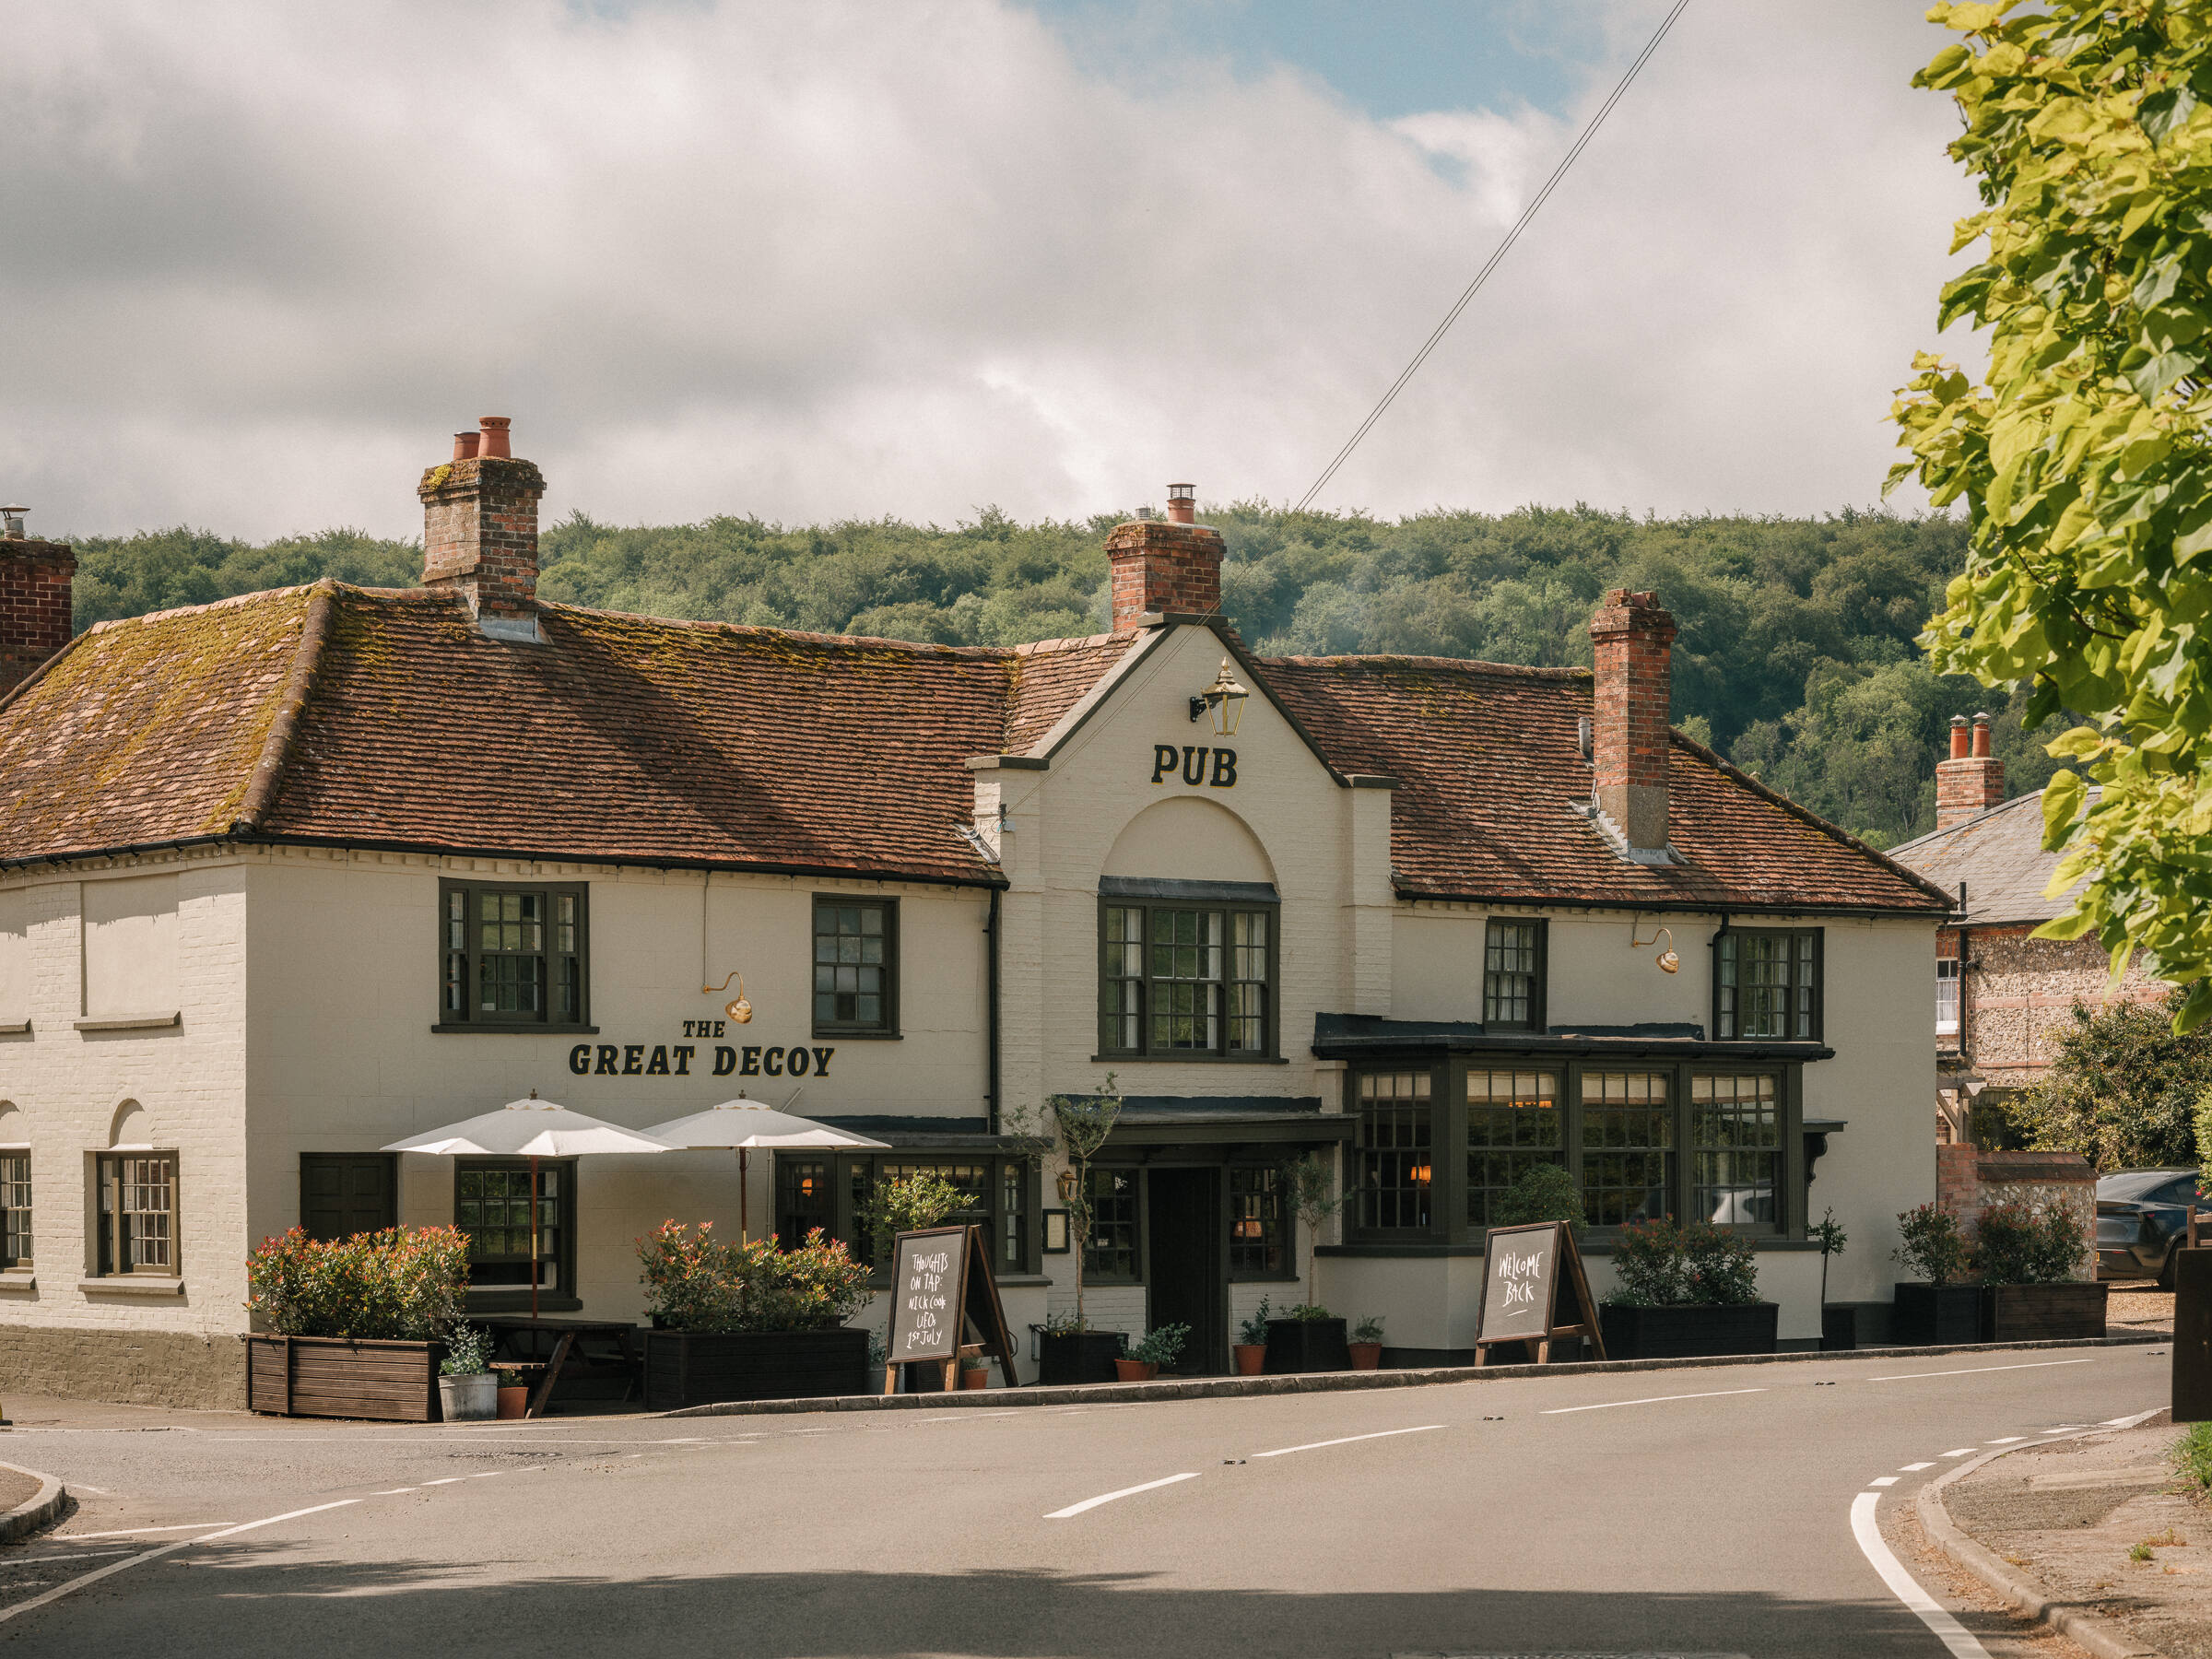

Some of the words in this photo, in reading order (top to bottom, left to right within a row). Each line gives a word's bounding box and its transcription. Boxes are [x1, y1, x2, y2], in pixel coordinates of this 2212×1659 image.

[1150, 744, 1238, 789] PUB
[682, 1020, 726, 1038] THE
[569, 1044, 695, 1076] GREAT
[712, 1046, 835, 1077] DECOY
[912, 1253, 948, 1273] THOUGHTS
[1499, 1251, 1544, 1280] WELCOME
[910, 1277, 921, 1290] ON
[924, 1272, 943, 1292] TAP:
[908, 1294, 928, 1310] NICK
[1502, 1280, 1535, 1308] BACK
[920, 1328, 943, 1346] JULY
